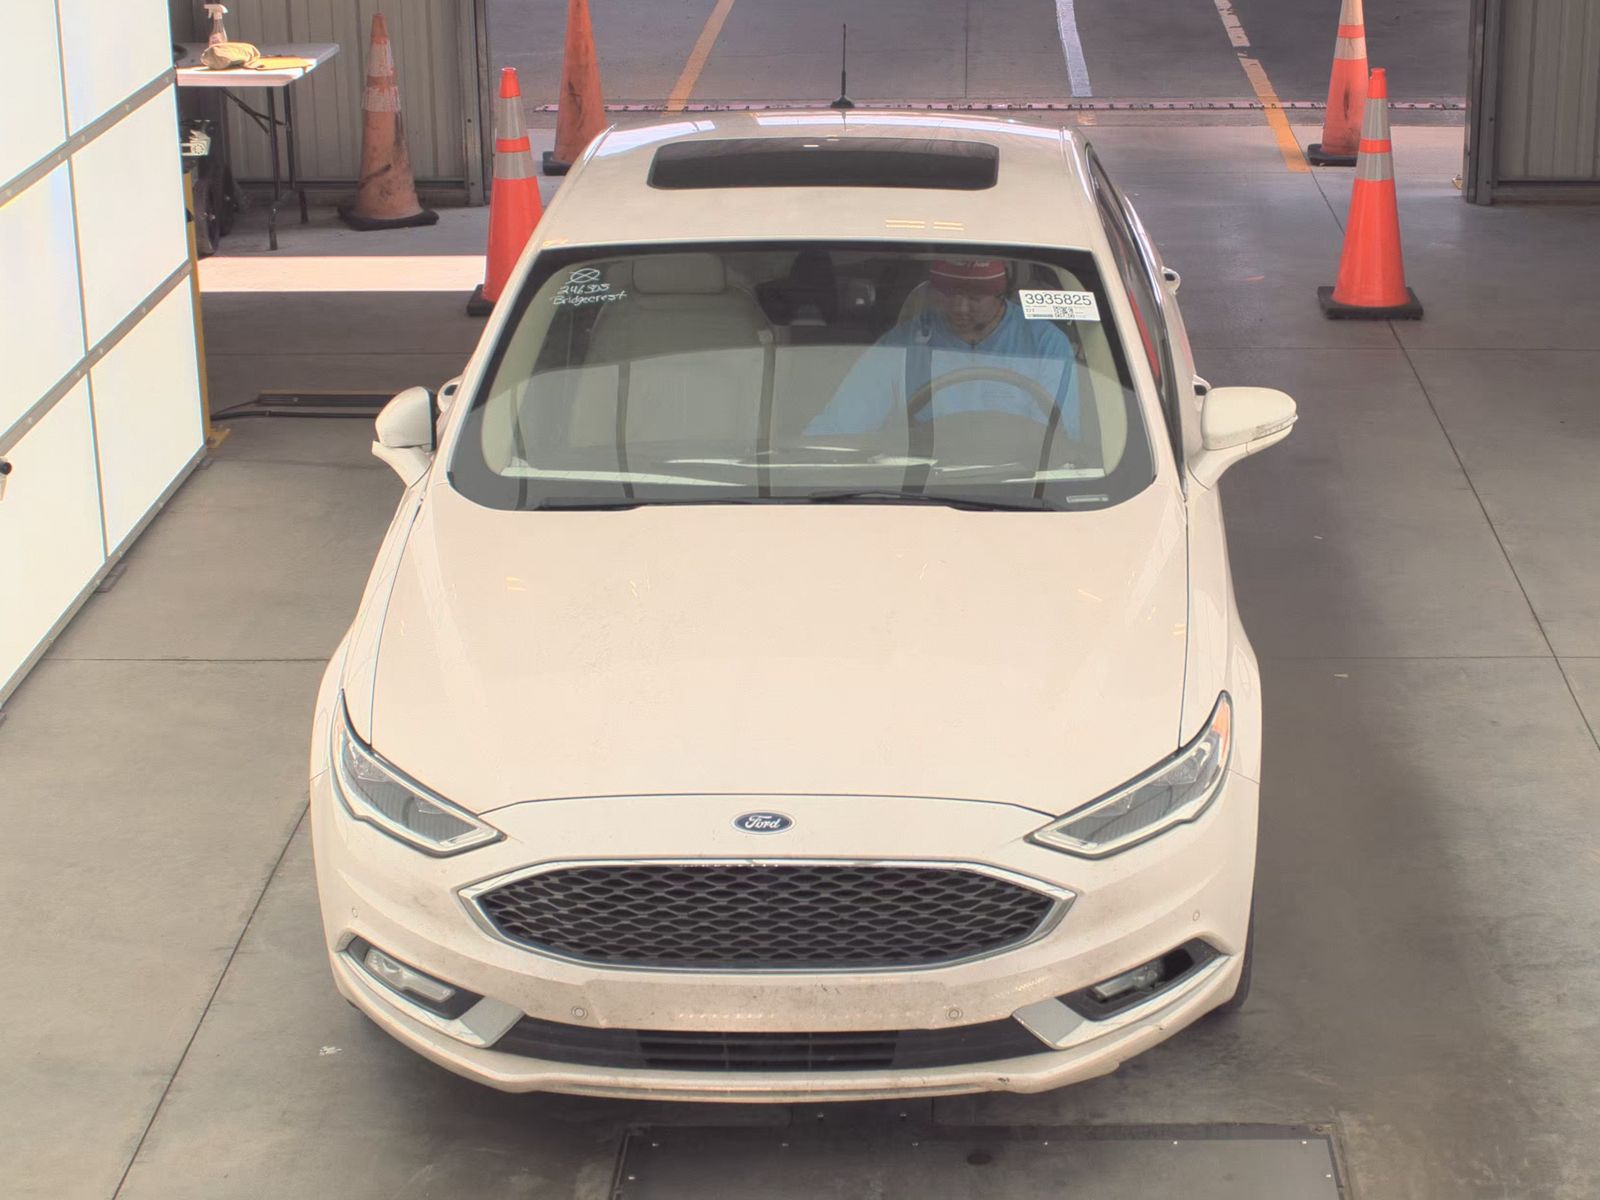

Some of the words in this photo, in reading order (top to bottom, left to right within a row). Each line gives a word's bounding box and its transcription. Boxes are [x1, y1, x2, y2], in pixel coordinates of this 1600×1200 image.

[553, 290, 627, 306] Bridgecrest
[1025, 293, 1092, 306] 3935825
[745, 815, 781, 828] Ford
